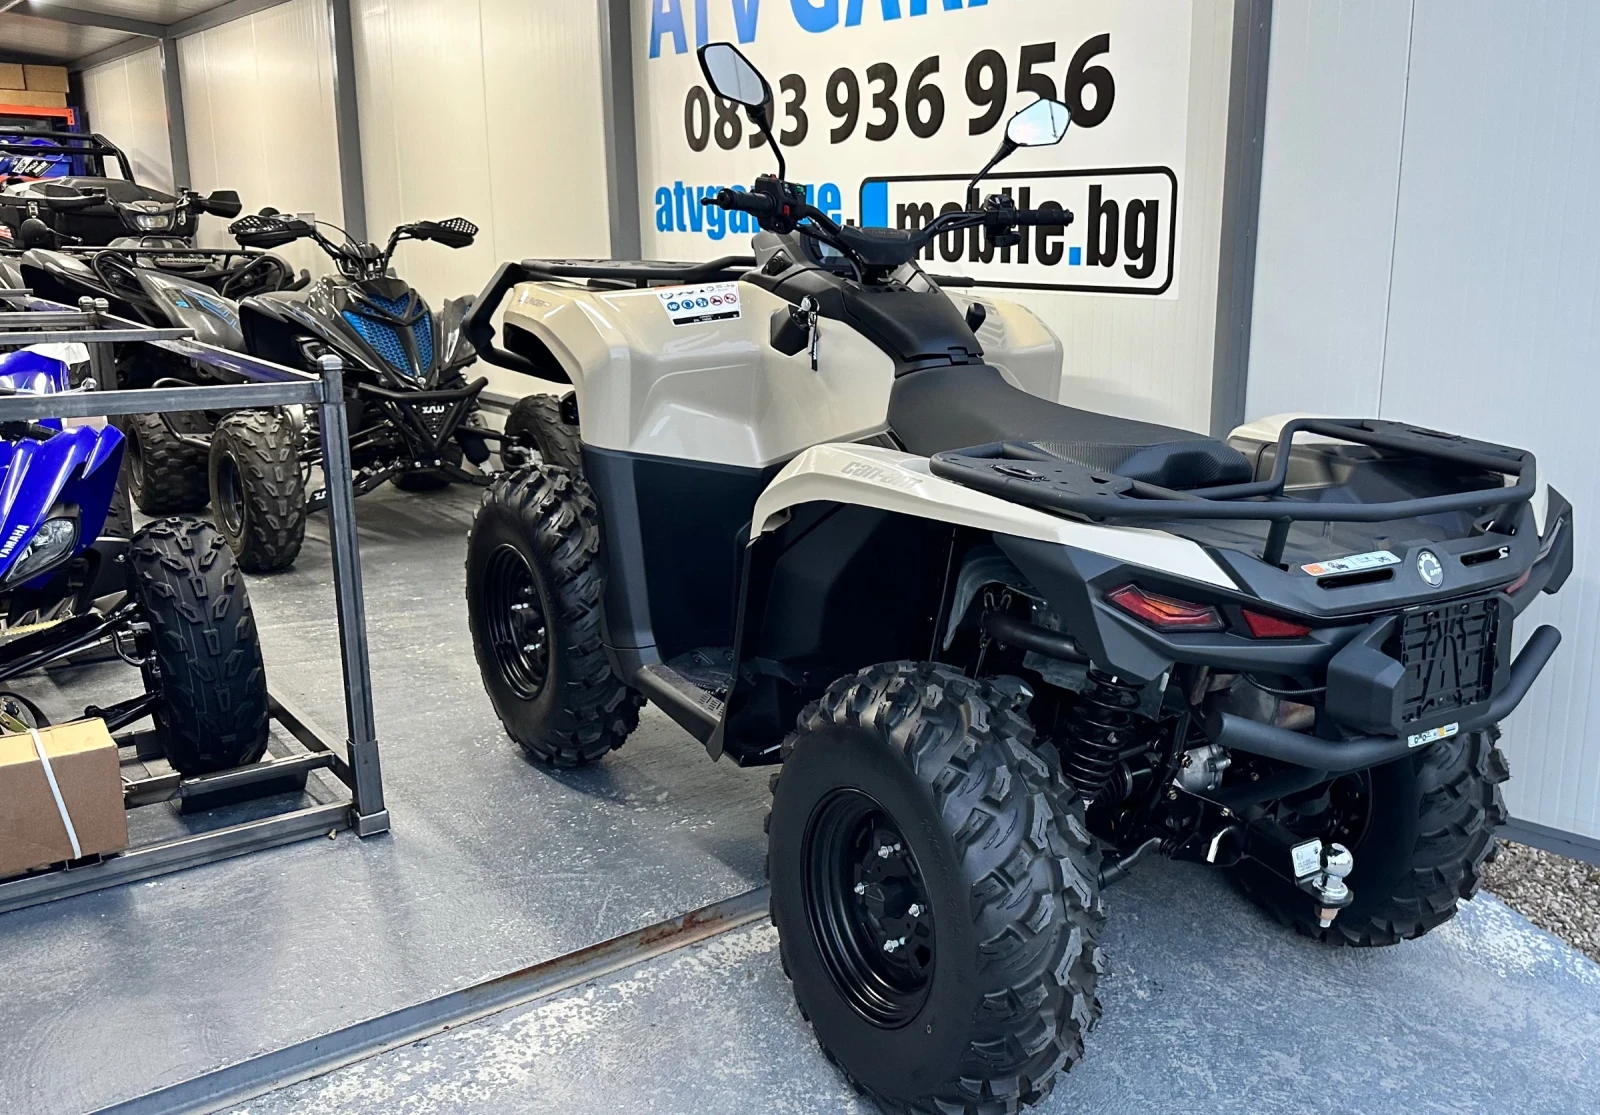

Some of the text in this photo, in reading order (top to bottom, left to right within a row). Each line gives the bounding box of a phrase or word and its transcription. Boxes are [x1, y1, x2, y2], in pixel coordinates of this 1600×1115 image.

[825, 55, 945, 144] 936
[965, 33, 1115, 136] 956
[896, 184, 1160, 279] moble.bg
